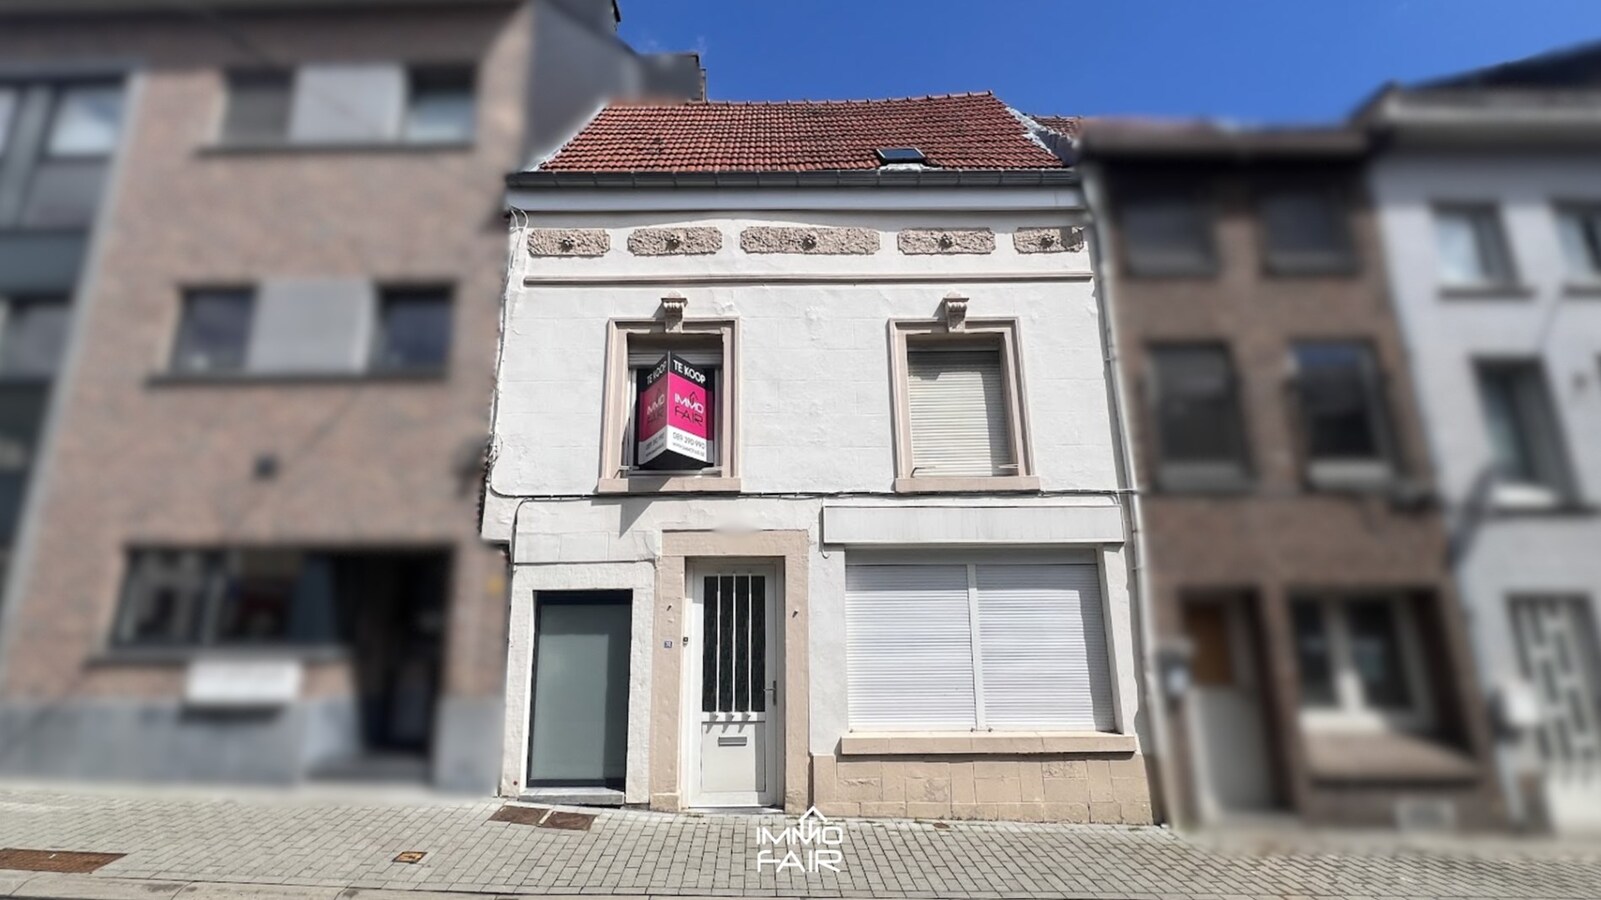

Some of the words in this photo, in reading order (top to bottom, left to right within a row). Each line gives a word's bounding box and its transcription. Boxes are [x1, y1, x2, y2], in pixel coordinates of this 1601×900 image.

[673, 359, 683, 374] TE
[684, 365, 706, 384] KOOP
[674, 392, 704, 414] IMMO
[674, 405, 704, 427] FAIR
